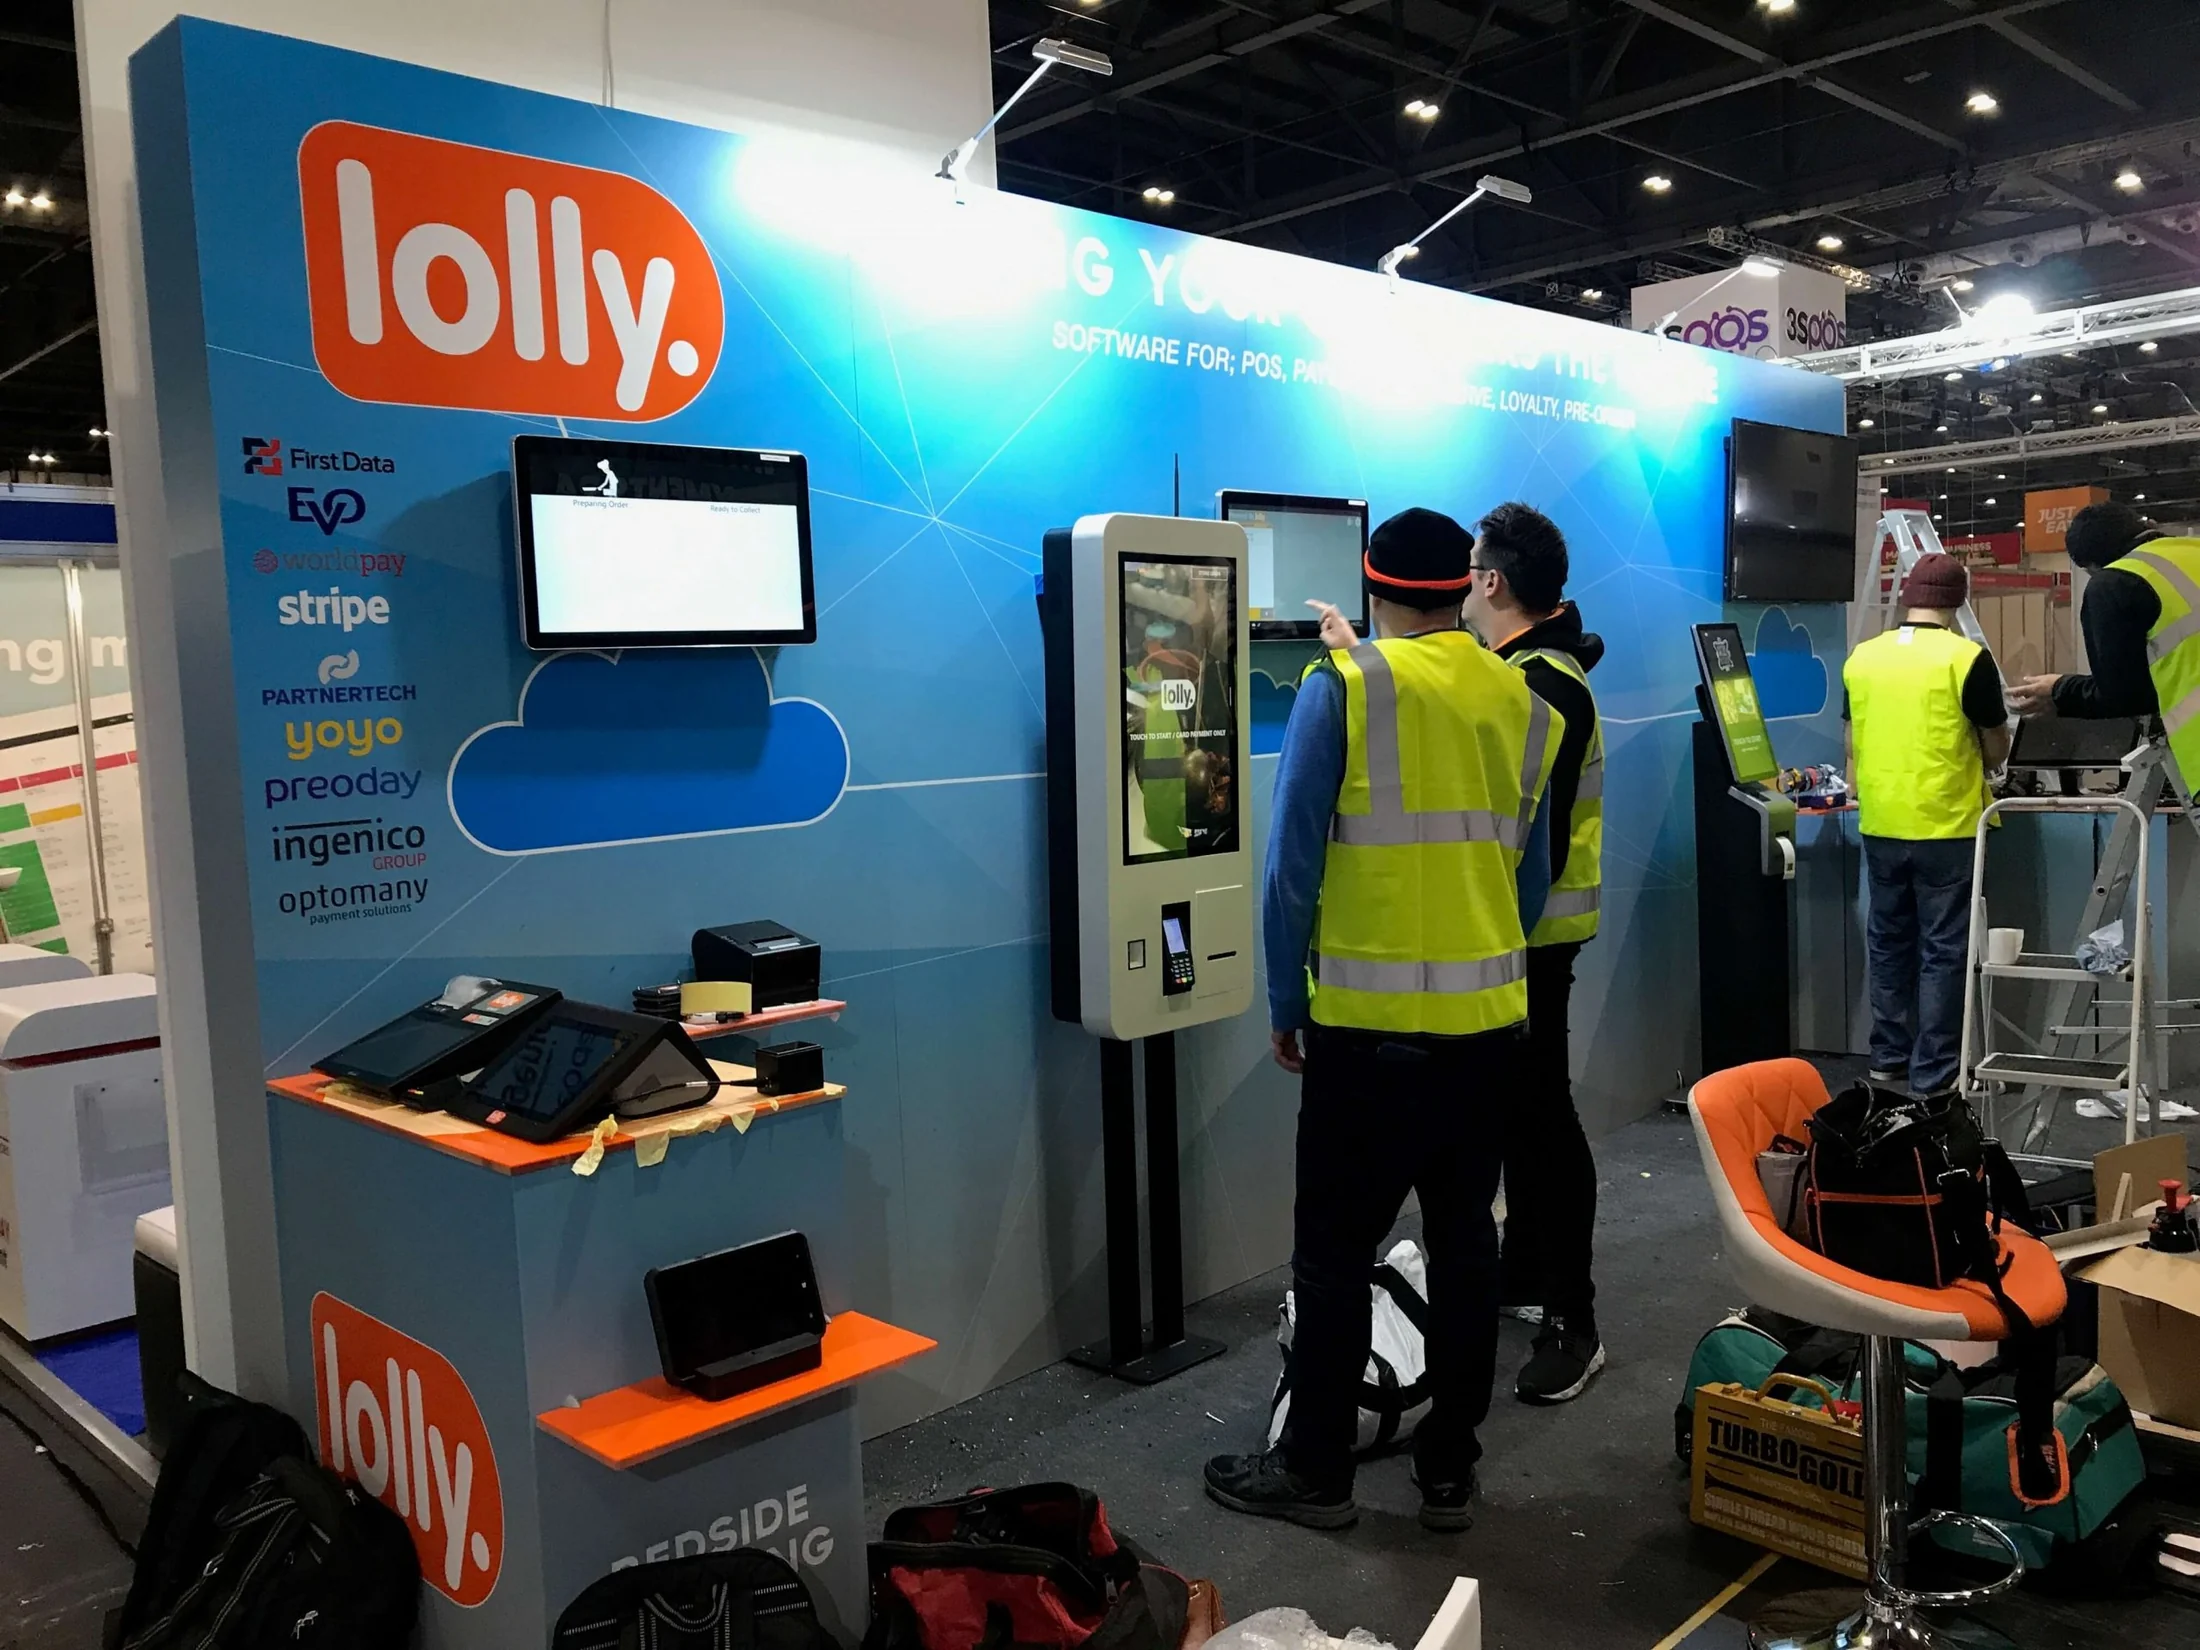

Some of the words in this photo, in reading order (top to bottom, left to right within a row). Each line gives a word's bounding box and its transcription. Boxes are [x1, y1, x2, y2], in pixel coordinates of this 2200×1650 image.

[336, 158, 699, 412] lolly.
[1052, 321, 1180, 366] SOFTWARE
[1186, 343, 1236, 377] FOR;
[1241, 350, 1288, 385] POS,
[1500, 391, 1560, 421] LOYALTY,
[290, 448, 341, 471] First
[342, 451, 396, 474] Data
[287, 486, 366, 536] EVO
[572, 499, 607, 509] Preparing
[608, 500, 629, 509] Order
[711, 504, 730, 514] Ready
[739, 505, 761, 514] Collect
[2037, 506, 2078, 525] JUST
[2045, 521, 2071, 534] EA
[283, 547, 407, 577] worldpay
[278, 586, 391, 632] stripe
[262, 685, 417, 706] PARTNERTECH
[1163, 684, 1193, 709] lolly.
[286, 717, 403, 761] yoyo
[1130, 733, 1147, 741] TOUCH
[1213, 729, 1226, 737] ONLY
[265, 767, 422, 809] preoday
[272, 818, 425, 866] ingenico
[373, 853, 427, 871] GROUP
[279, 878, 428, 917] optomany
[310, 908, 361, 926] payment
[362, 903, 412, 918] solutions
[323, 1322, 490, 1591] lolly.
